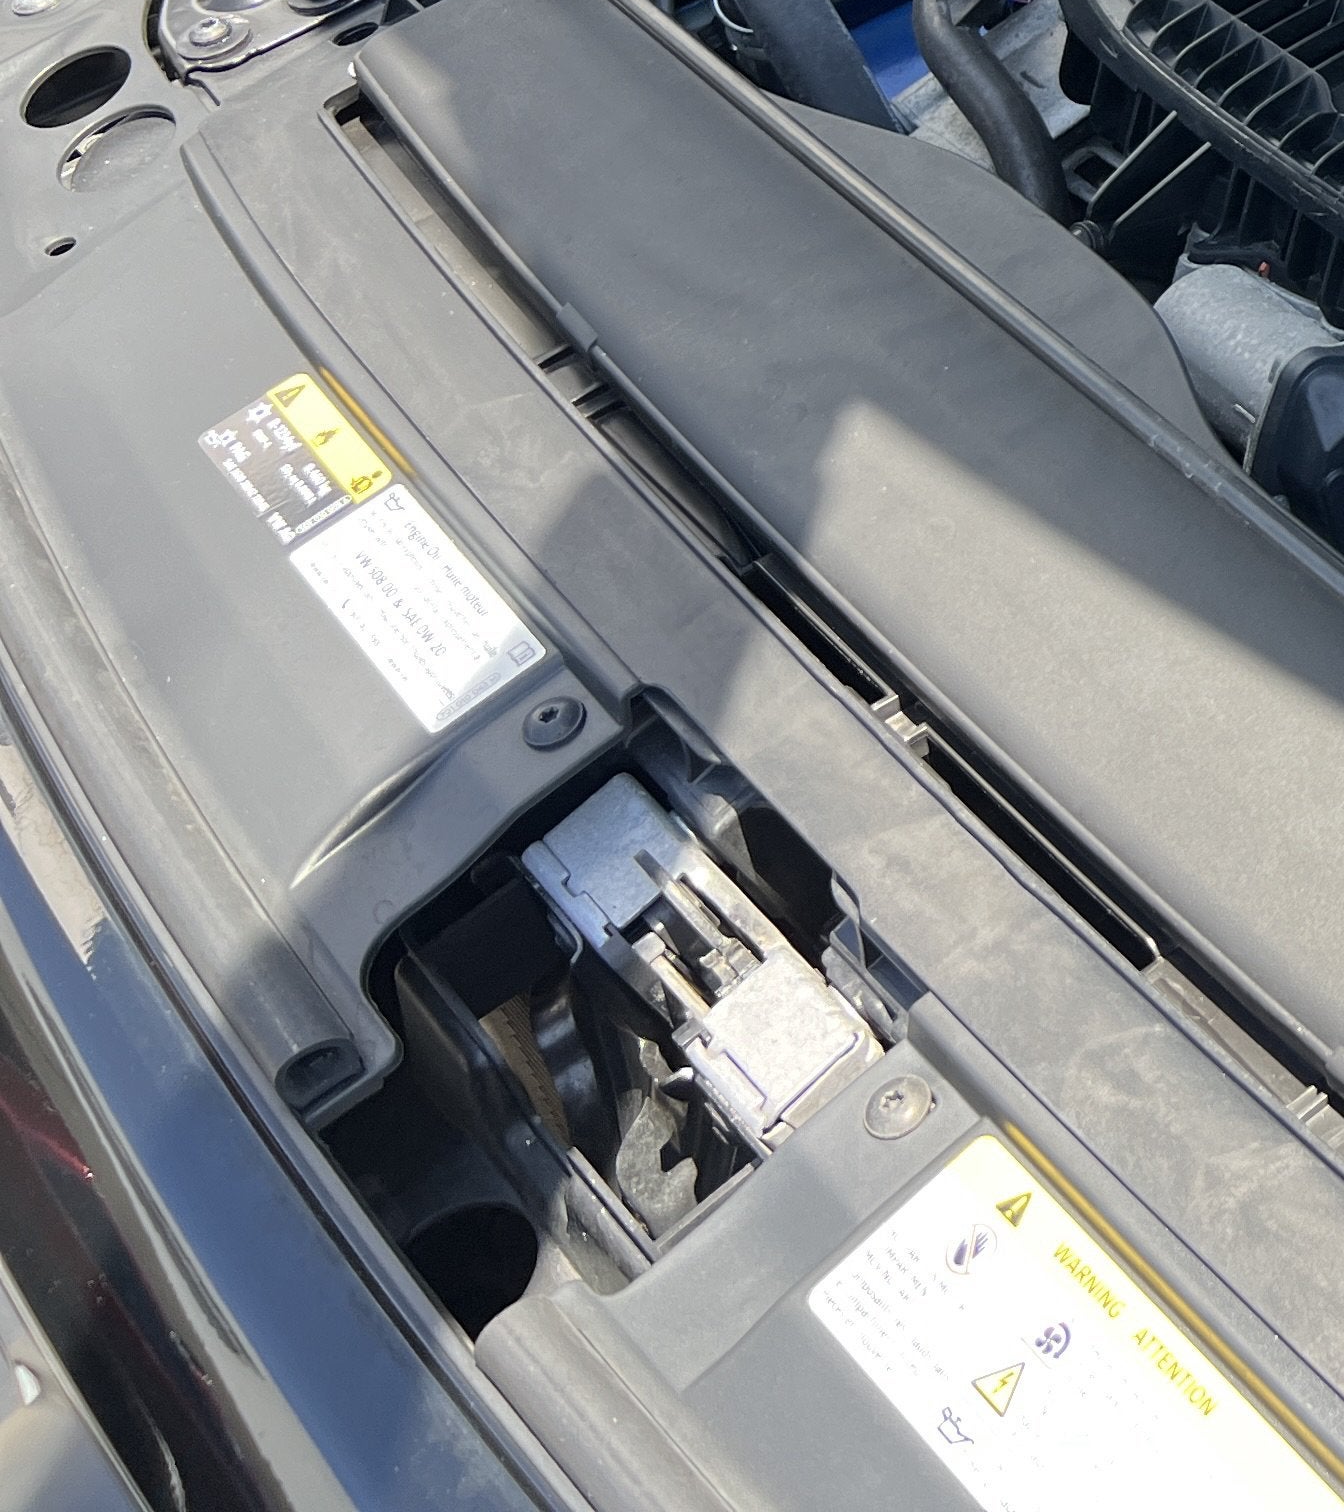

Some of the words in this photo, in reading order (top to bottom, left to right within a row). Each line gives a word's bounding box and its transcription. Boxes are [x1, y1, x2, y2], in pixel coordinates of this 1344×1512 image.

[353, 549, 374, 572] VW
[1054, 1241, 1125, 1320] WARNING
[1134, 1327, 1217, 1417] ATTENTION
